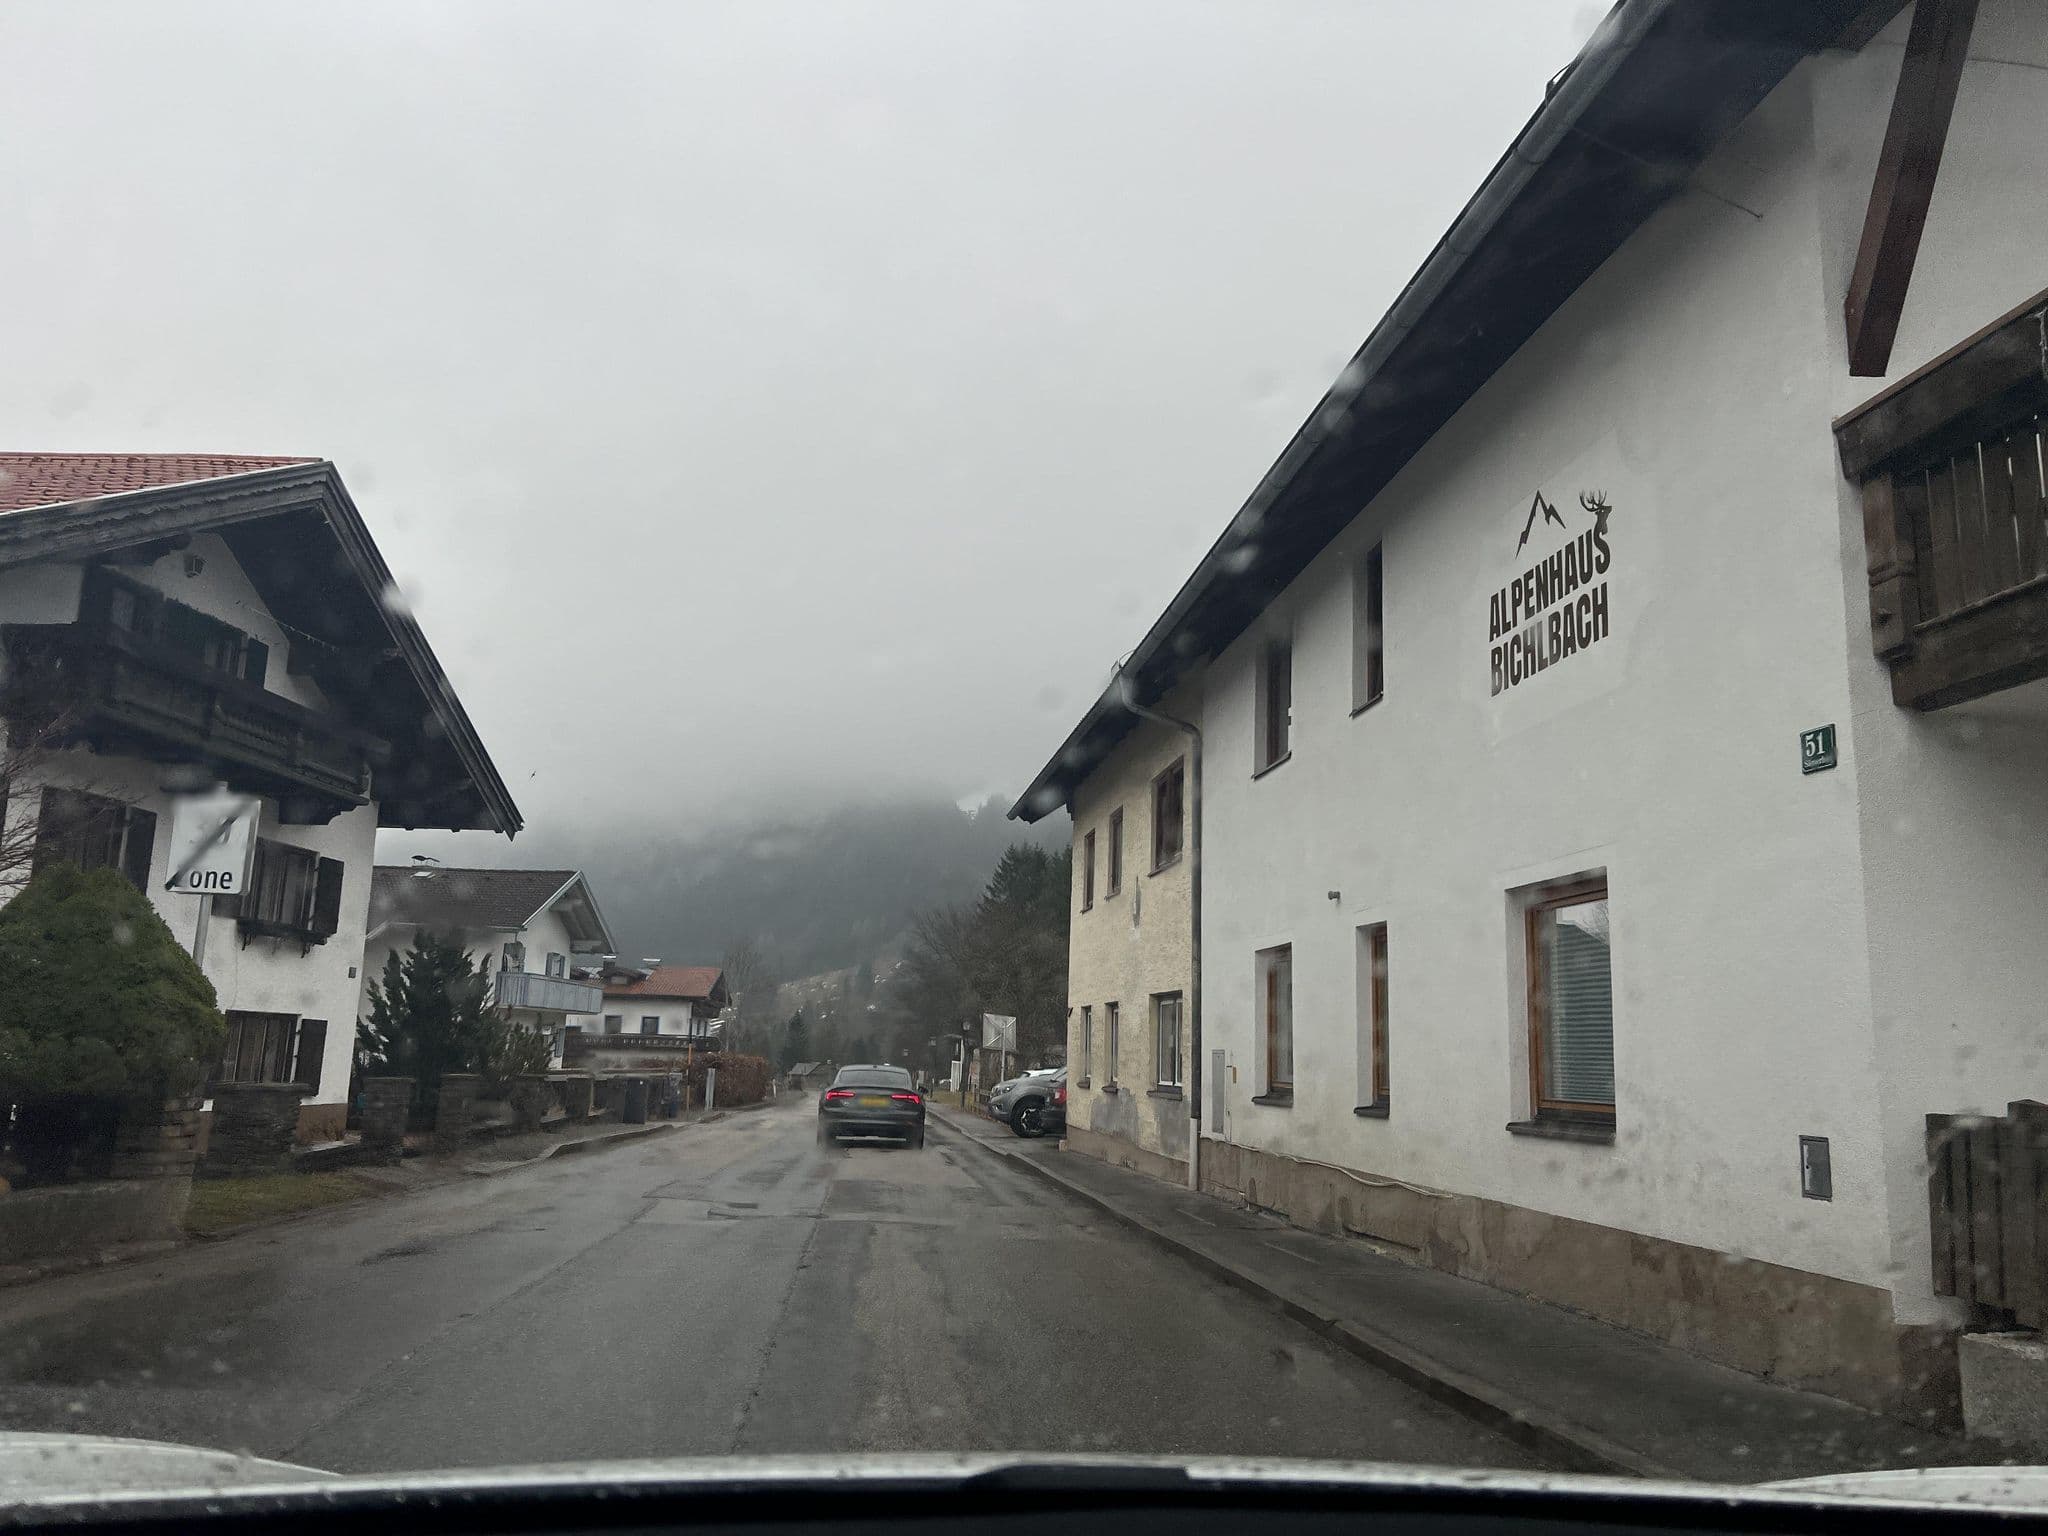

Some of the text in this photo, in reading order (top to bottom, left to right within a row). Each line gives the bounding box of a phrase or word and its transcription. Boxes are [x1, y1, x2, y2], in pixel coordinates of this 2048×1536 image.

[1489, 529, 1611, 643] ALPENHAUS
[1490, 581, 1609, 698] BICHLBACH
[1805, 732, 1826, 757] 51
[176, 868, 233, 890] one
